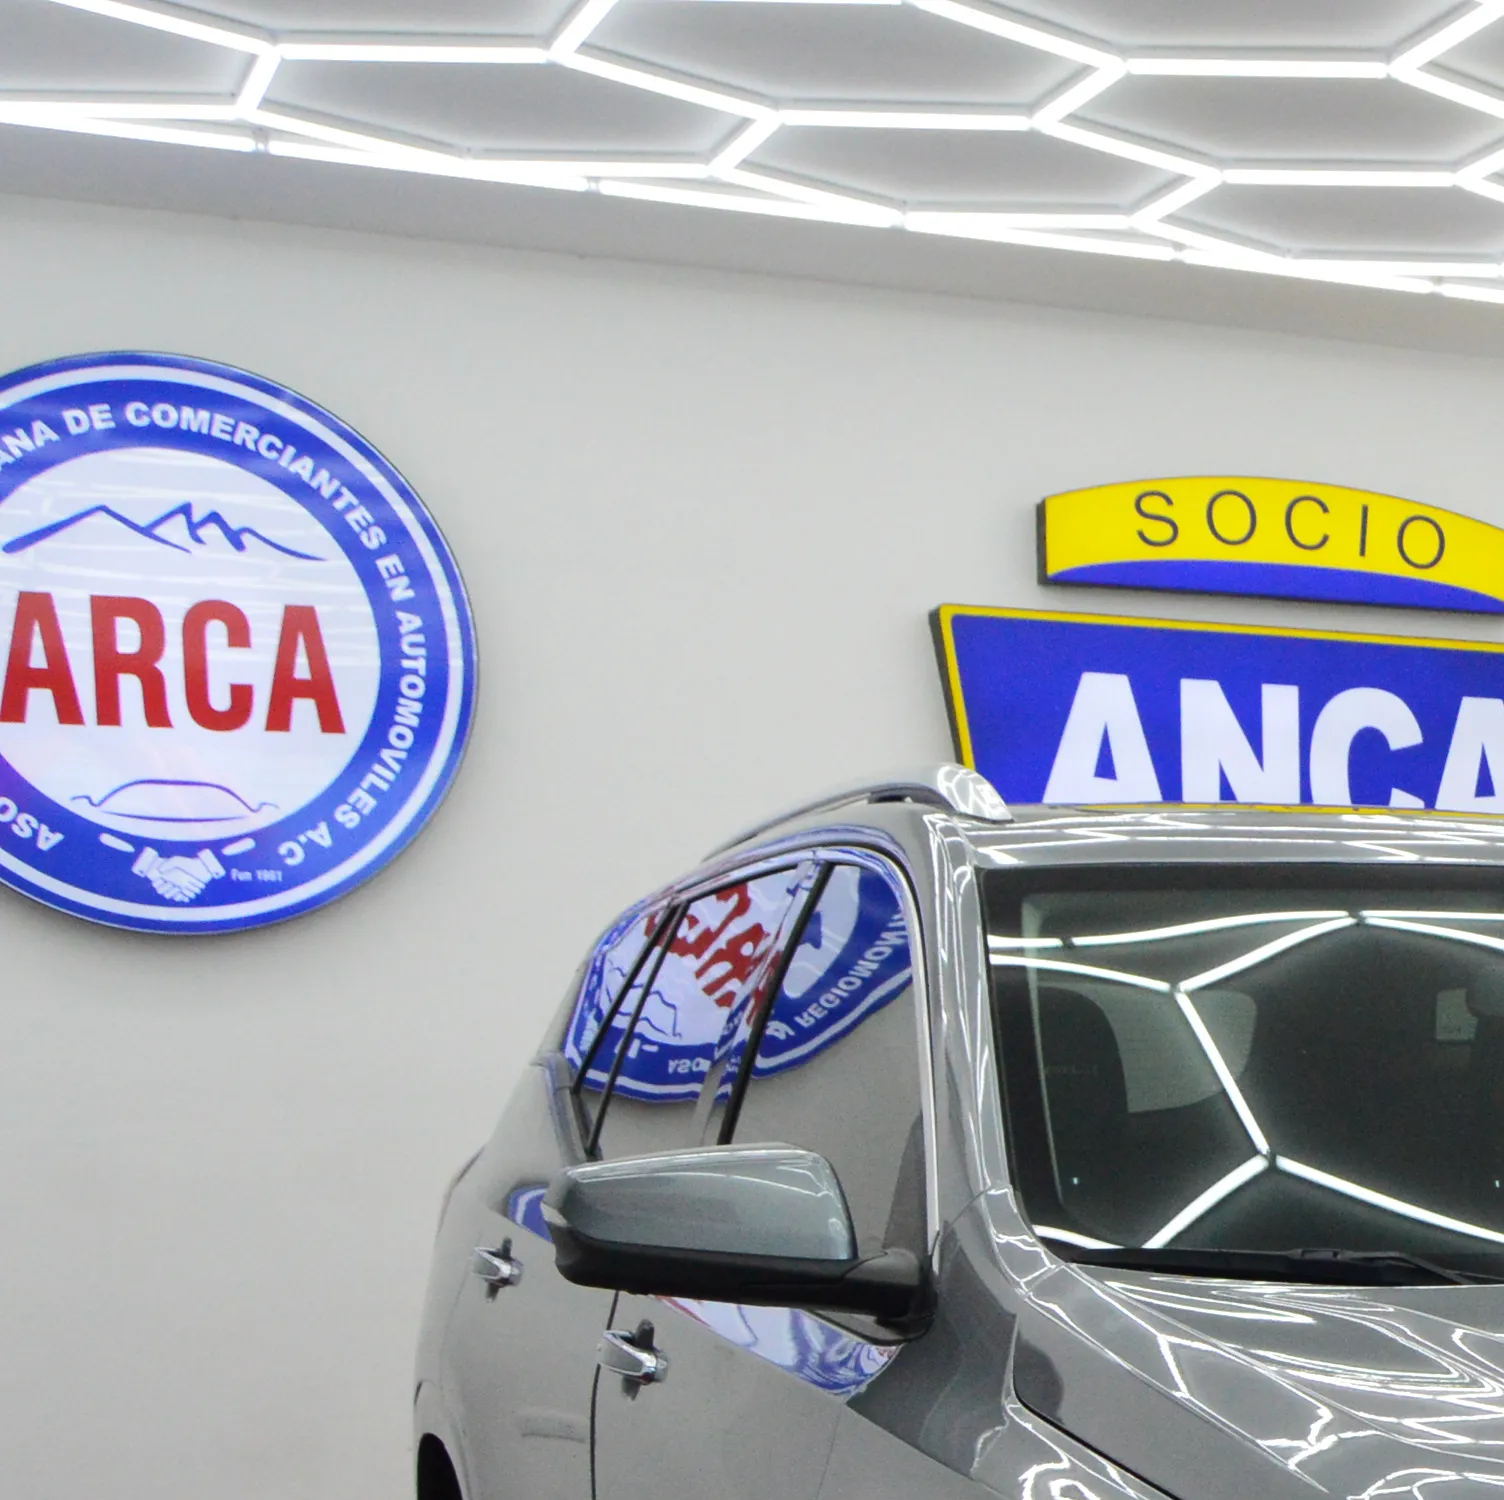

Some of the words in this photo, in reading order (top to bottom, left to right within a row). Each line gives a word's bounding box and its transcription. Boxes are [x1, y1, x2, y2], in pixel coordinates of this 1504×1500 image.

[62, 403, 116, 436] DE
[125, 401, 386, 550] COMERCIANTES
[1136, 489, 1446, 569] SOCIO
[375, 553, 415, 604] EN
[0, 591, 346, 734] ARCA
[338, 612, 428, 832] AUTOMOVILES
